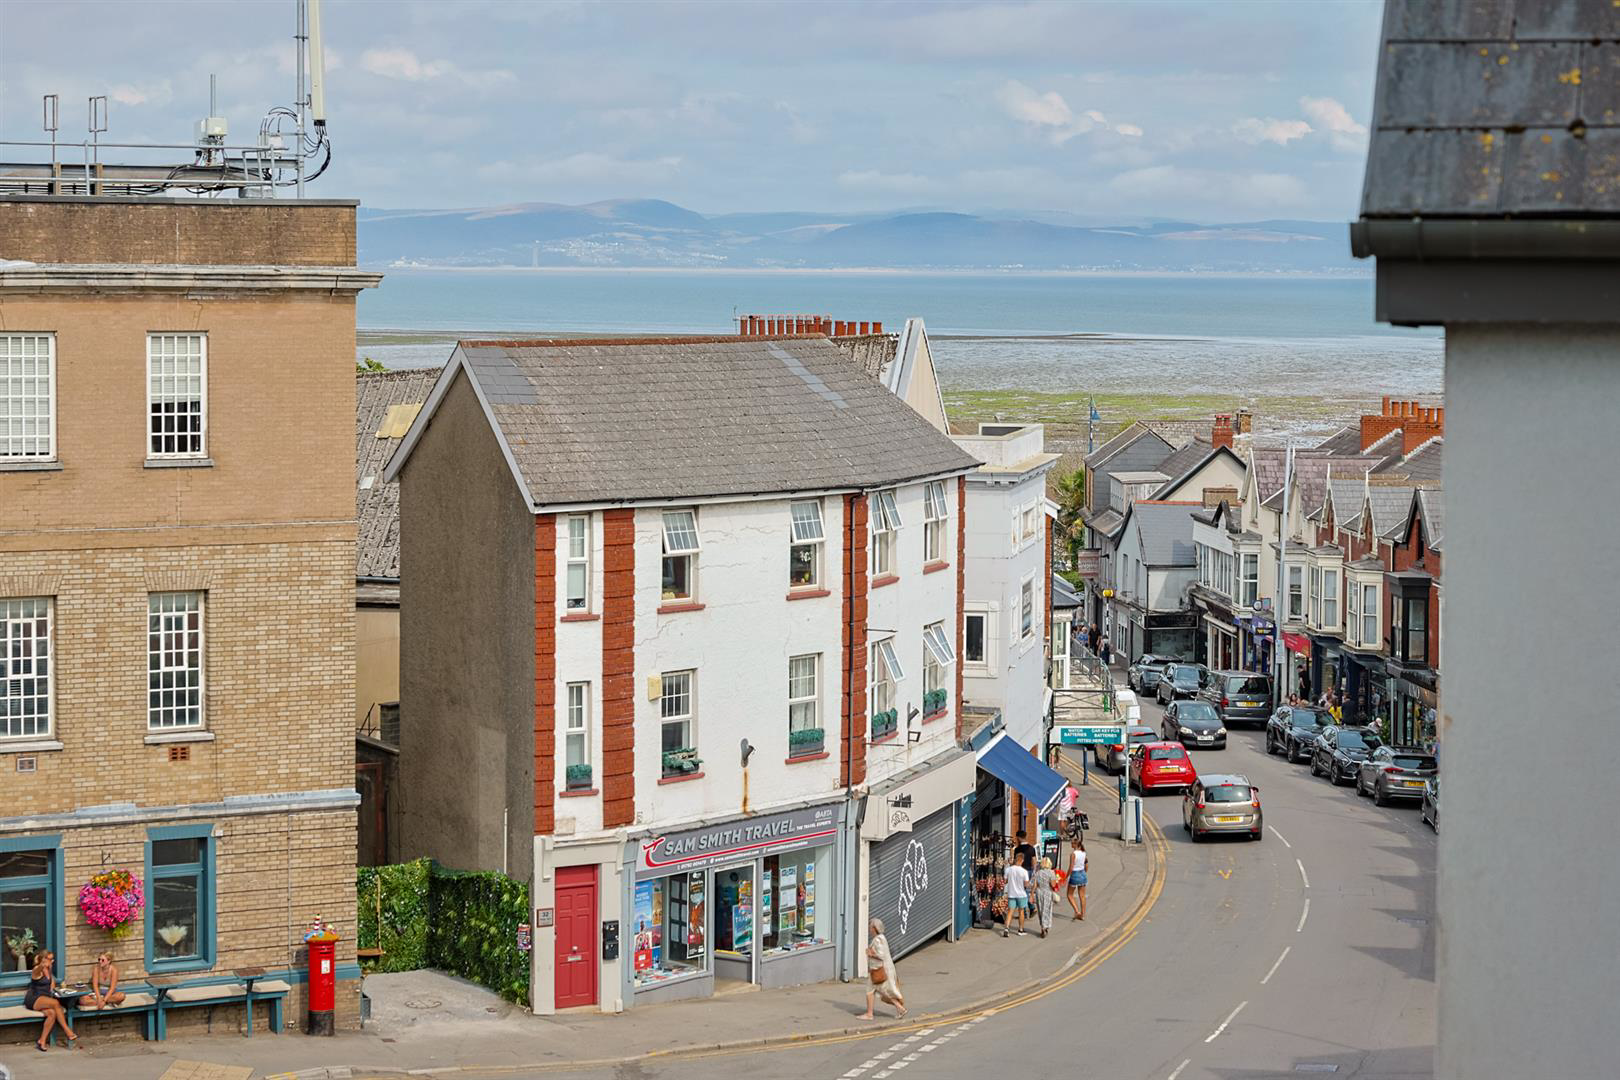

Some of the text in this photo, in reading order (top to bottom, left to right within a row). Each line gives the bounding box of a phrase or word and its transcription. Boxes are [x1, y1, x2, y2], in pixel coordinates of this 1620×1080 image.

[664, 837, 697, 856] SAM
[699, 829, 742, 850] SMITH
[745, 819, 795, 841] TRAVEL
